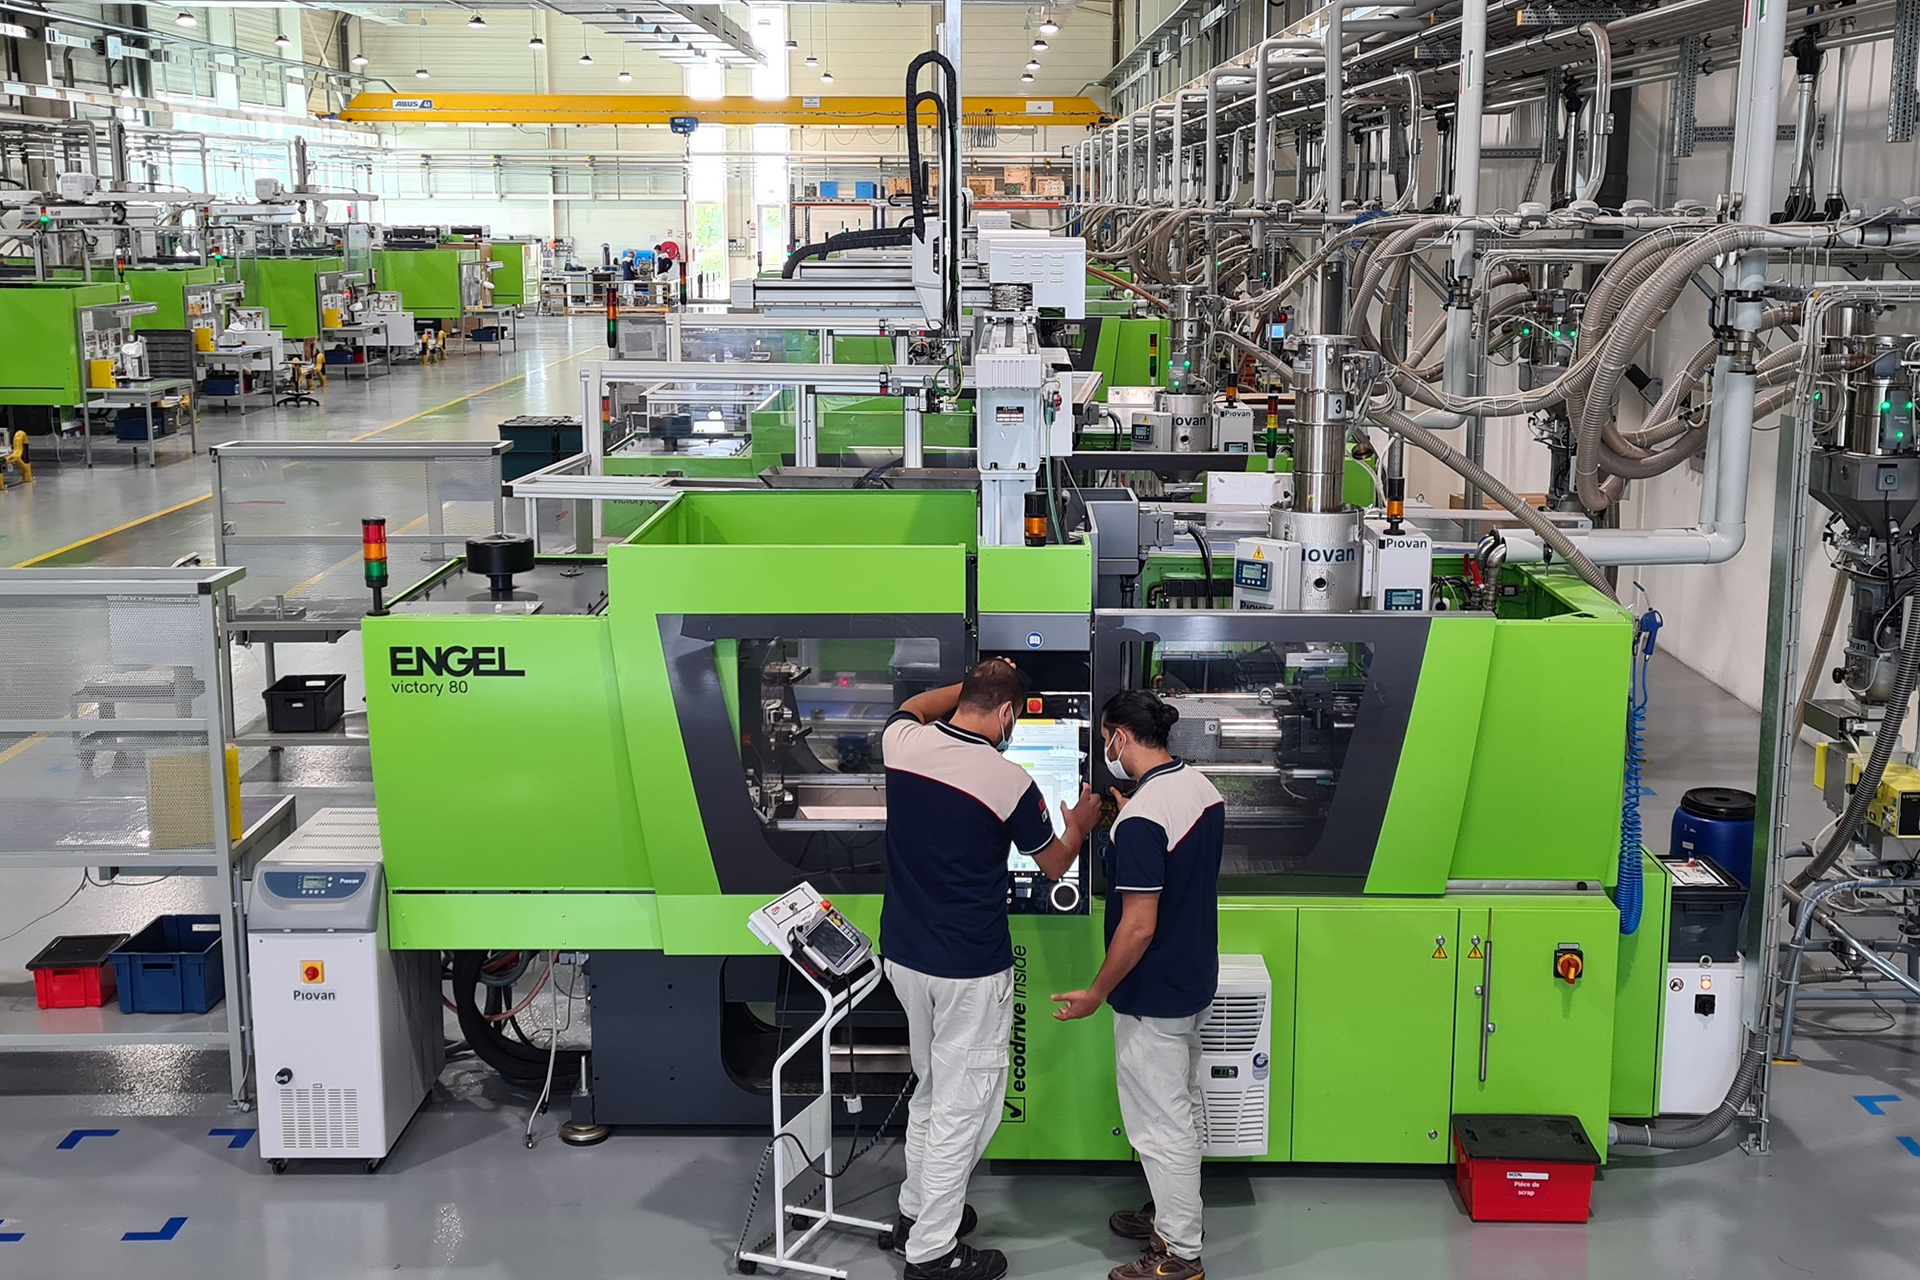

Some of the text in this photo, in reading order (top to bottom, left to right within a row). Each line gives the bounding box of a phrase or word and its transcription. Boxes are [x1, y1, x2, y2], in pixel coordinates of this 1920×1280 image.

[1188, 324, 1194, 334] 4
[1335, 399, 1342, 414] 3
[1172, 416, 1206, 427] iovan
[1387, 538, 1427, 549] Piovan
[1302, 547, 1355, 563] iovan
[389, 645, 526, 677] ENGEL
[391, 680, 468, 697] victory 80
[293, 990, 336, 1001] Piovan
[1009, 944, 1027, 1093] ecodrive inside
